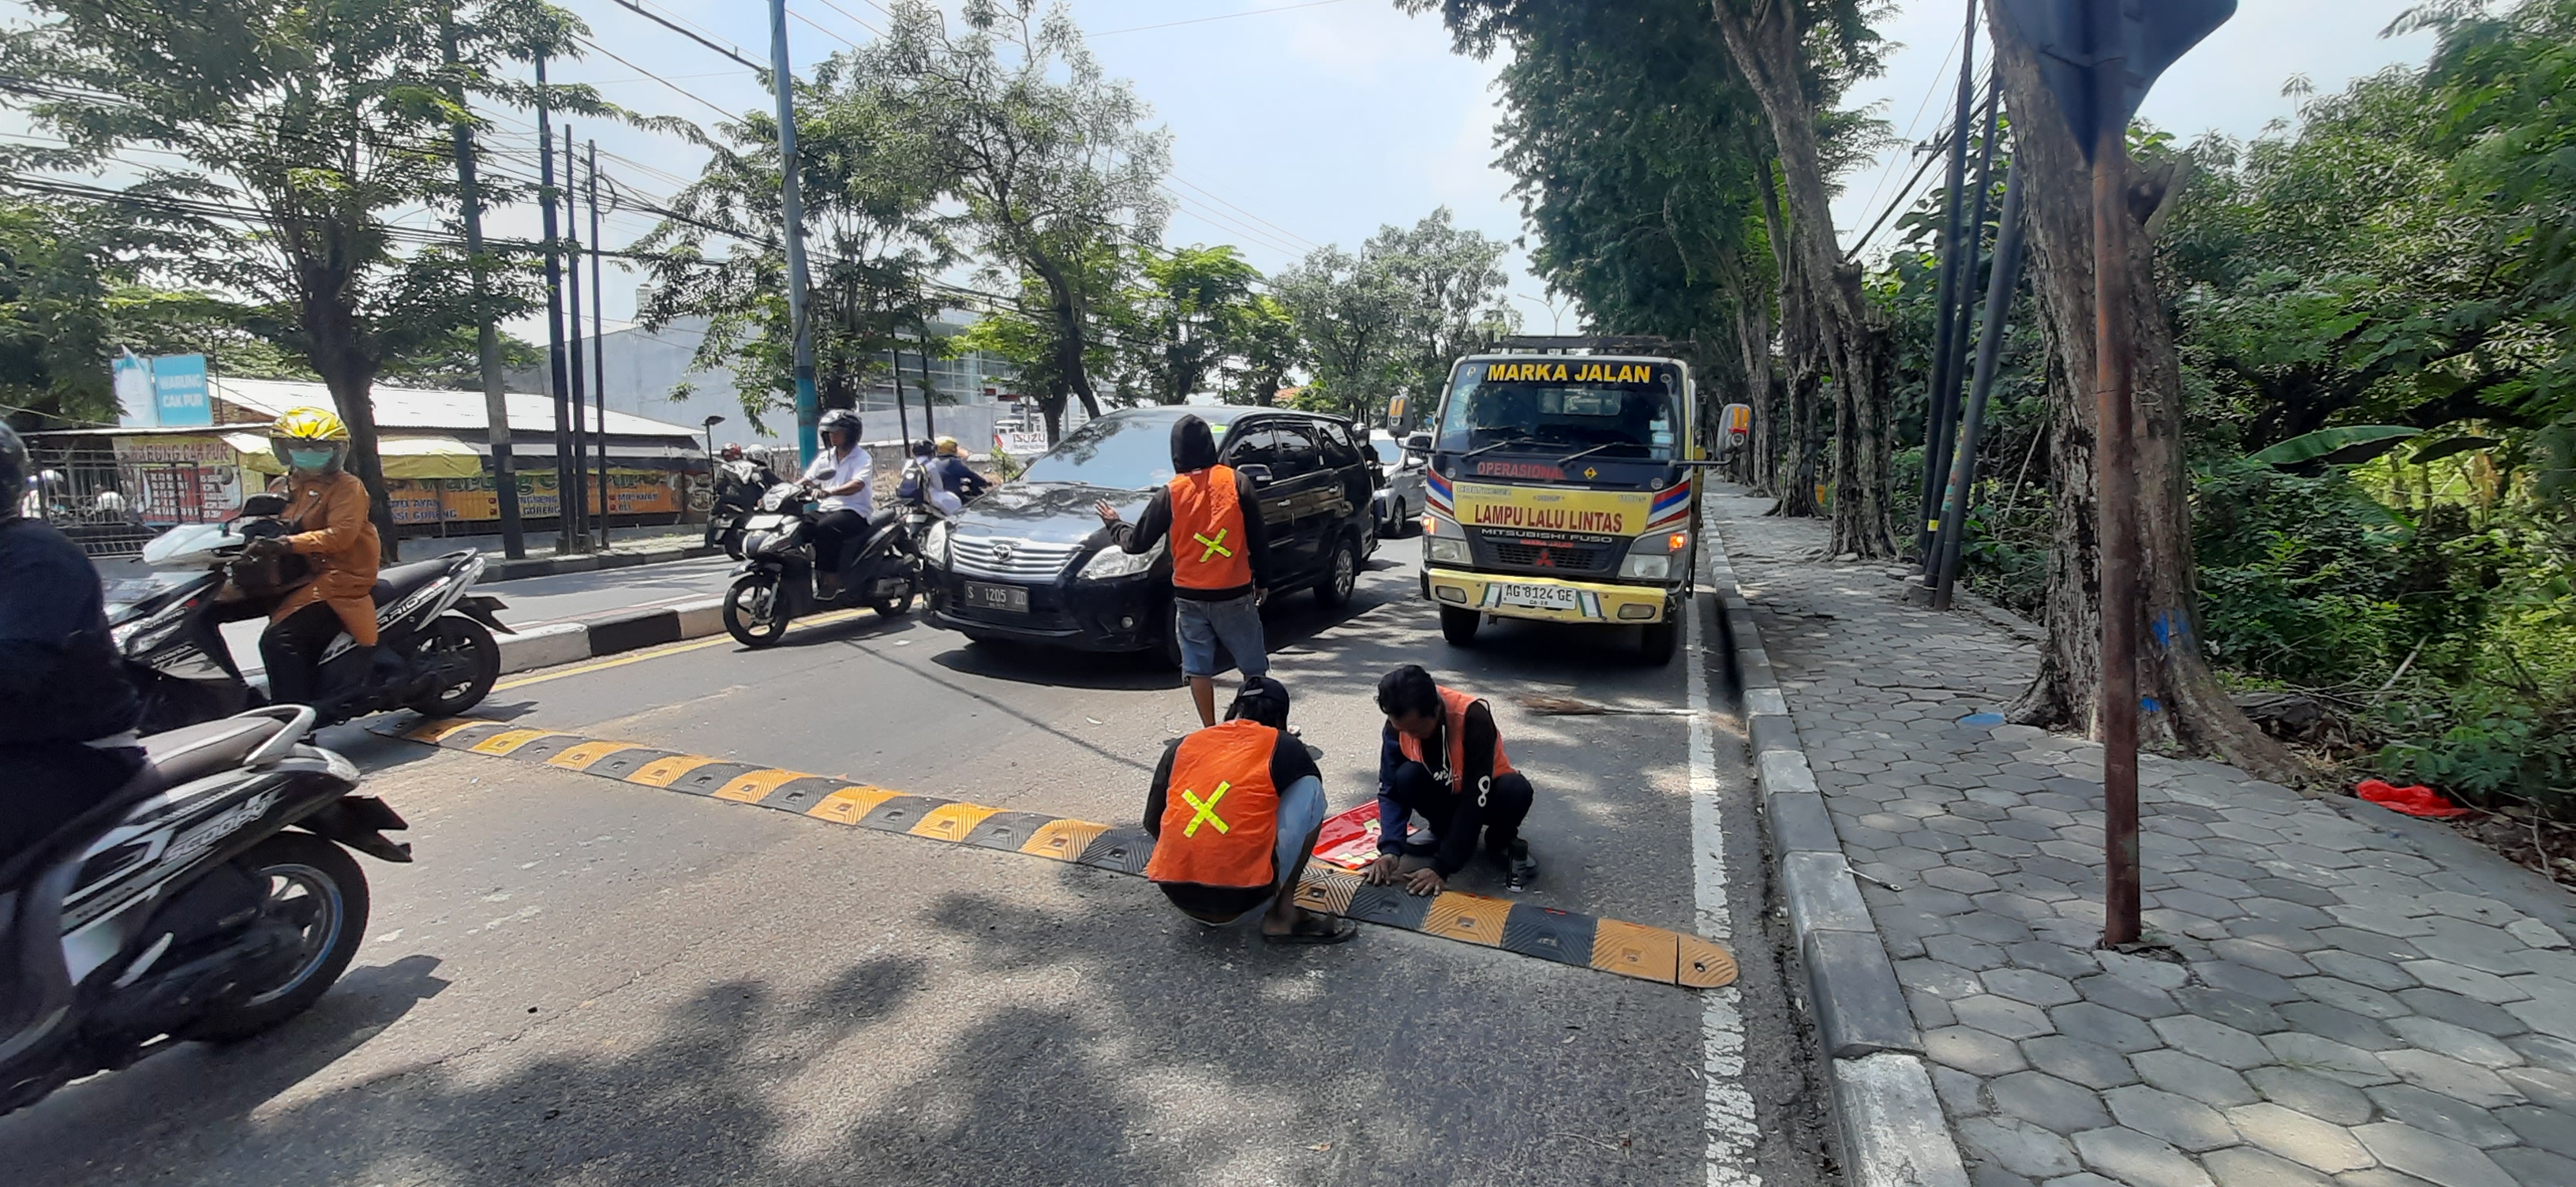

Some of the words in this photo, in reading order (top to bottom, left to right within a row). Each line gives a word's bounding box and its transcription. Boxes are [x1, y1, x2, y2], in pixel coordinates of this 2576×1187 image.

[1487, 364, 1567, 381] MARKA
[1574, 365, 1650, 383] JALAN
[159, 375, 202, 390] WARUNG
[163, 395, 183, 407] CAK
[184, 395, 203, 407] PUR
[1013, 433, 1045, 443] ISUZU
[1474, 504, 1523, 526] LAMPU
[1527, 507, 1564, 529] LALU
[1569, 511, 1623, 534] LINTAS
[1481, 528, 1566, 540] MITSUBISHI
[1570, 535, 1613, 544] FUSO
[968, 586, 975, 599] S
[985, 588, 1006, 603] 1205
[1506, 585, 1520, 597] AG
[1523, 586, 1553, 600] 8124
[1557, 590, 1573, 602] GE
[377, 597, 419, 625] ARIO
[161, 790, 276, 865] SCOOPY
